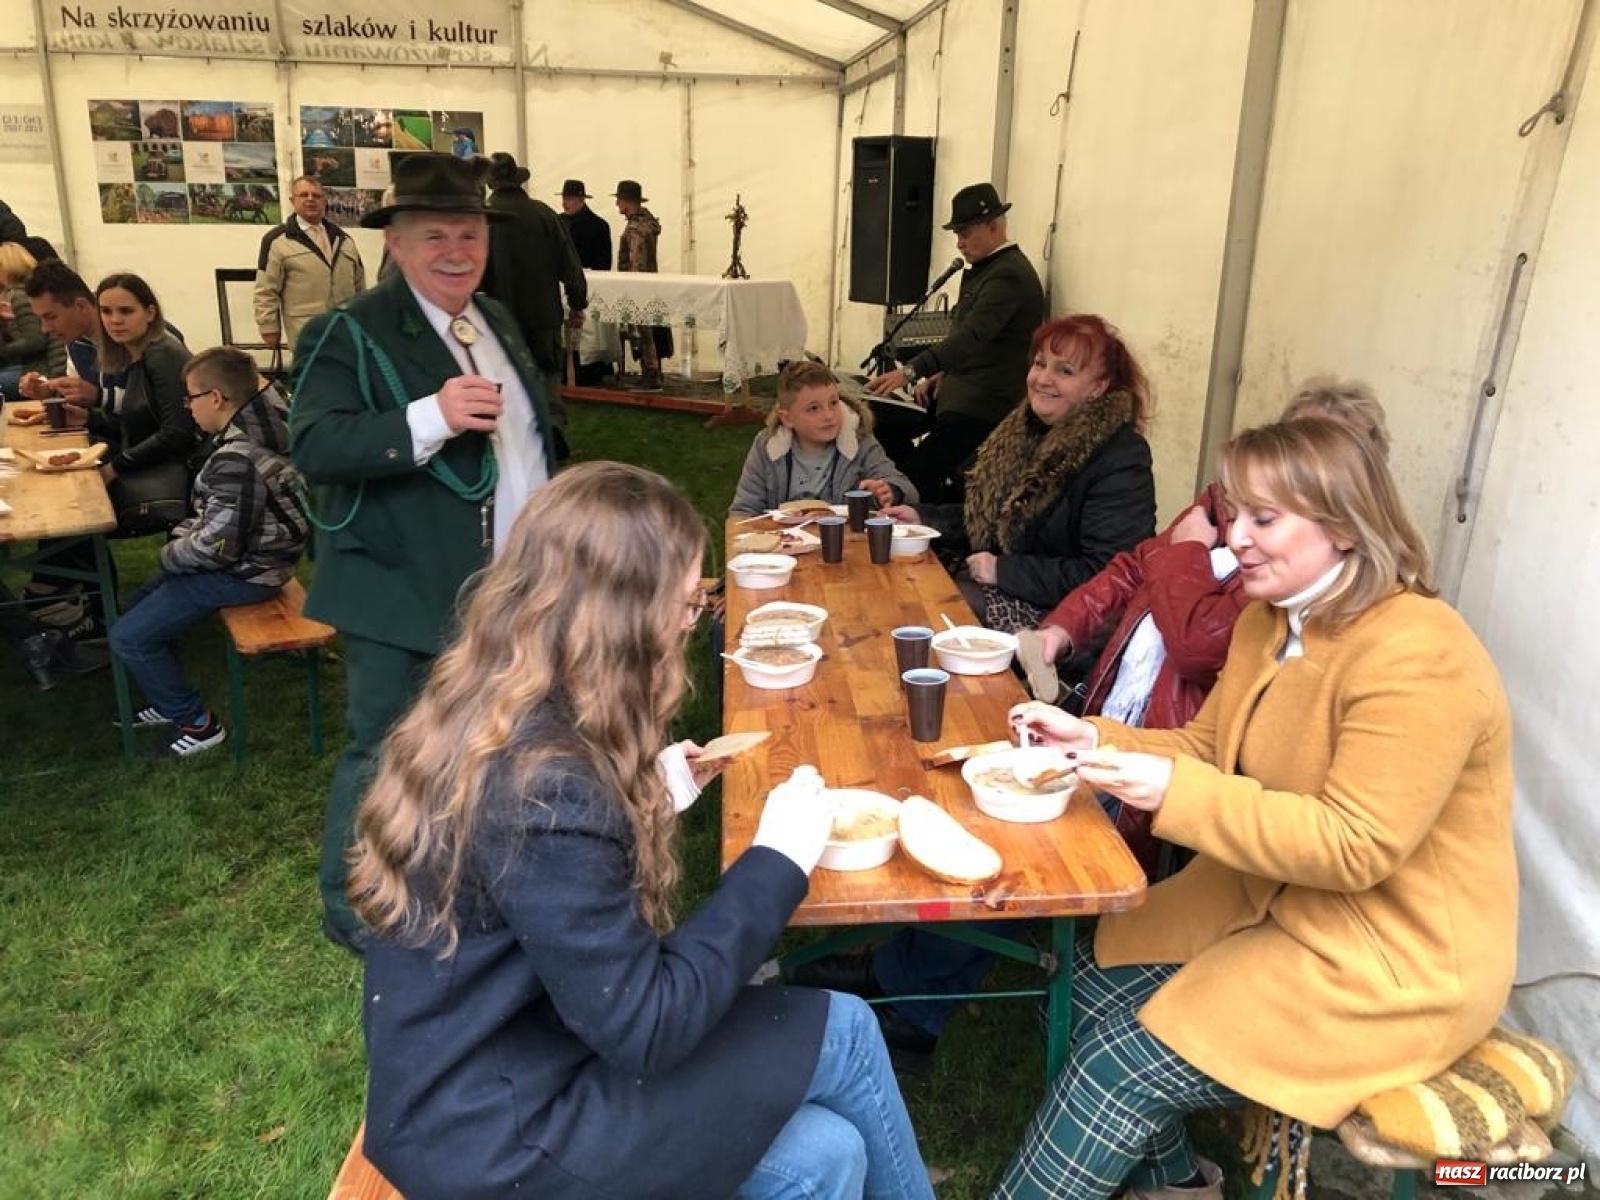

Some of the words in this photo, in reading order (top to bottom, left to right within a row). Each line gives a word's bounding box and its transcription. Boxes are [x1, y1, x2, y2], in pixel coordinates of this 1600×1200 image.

[61, 5, 95, 28] Na
[107, 5, 270, 33] skrzyżowaniu
[302, 14, 397, 39] szlaków
[409, 20, 416, 40] i
[428, 19, 498, 44] kultur
